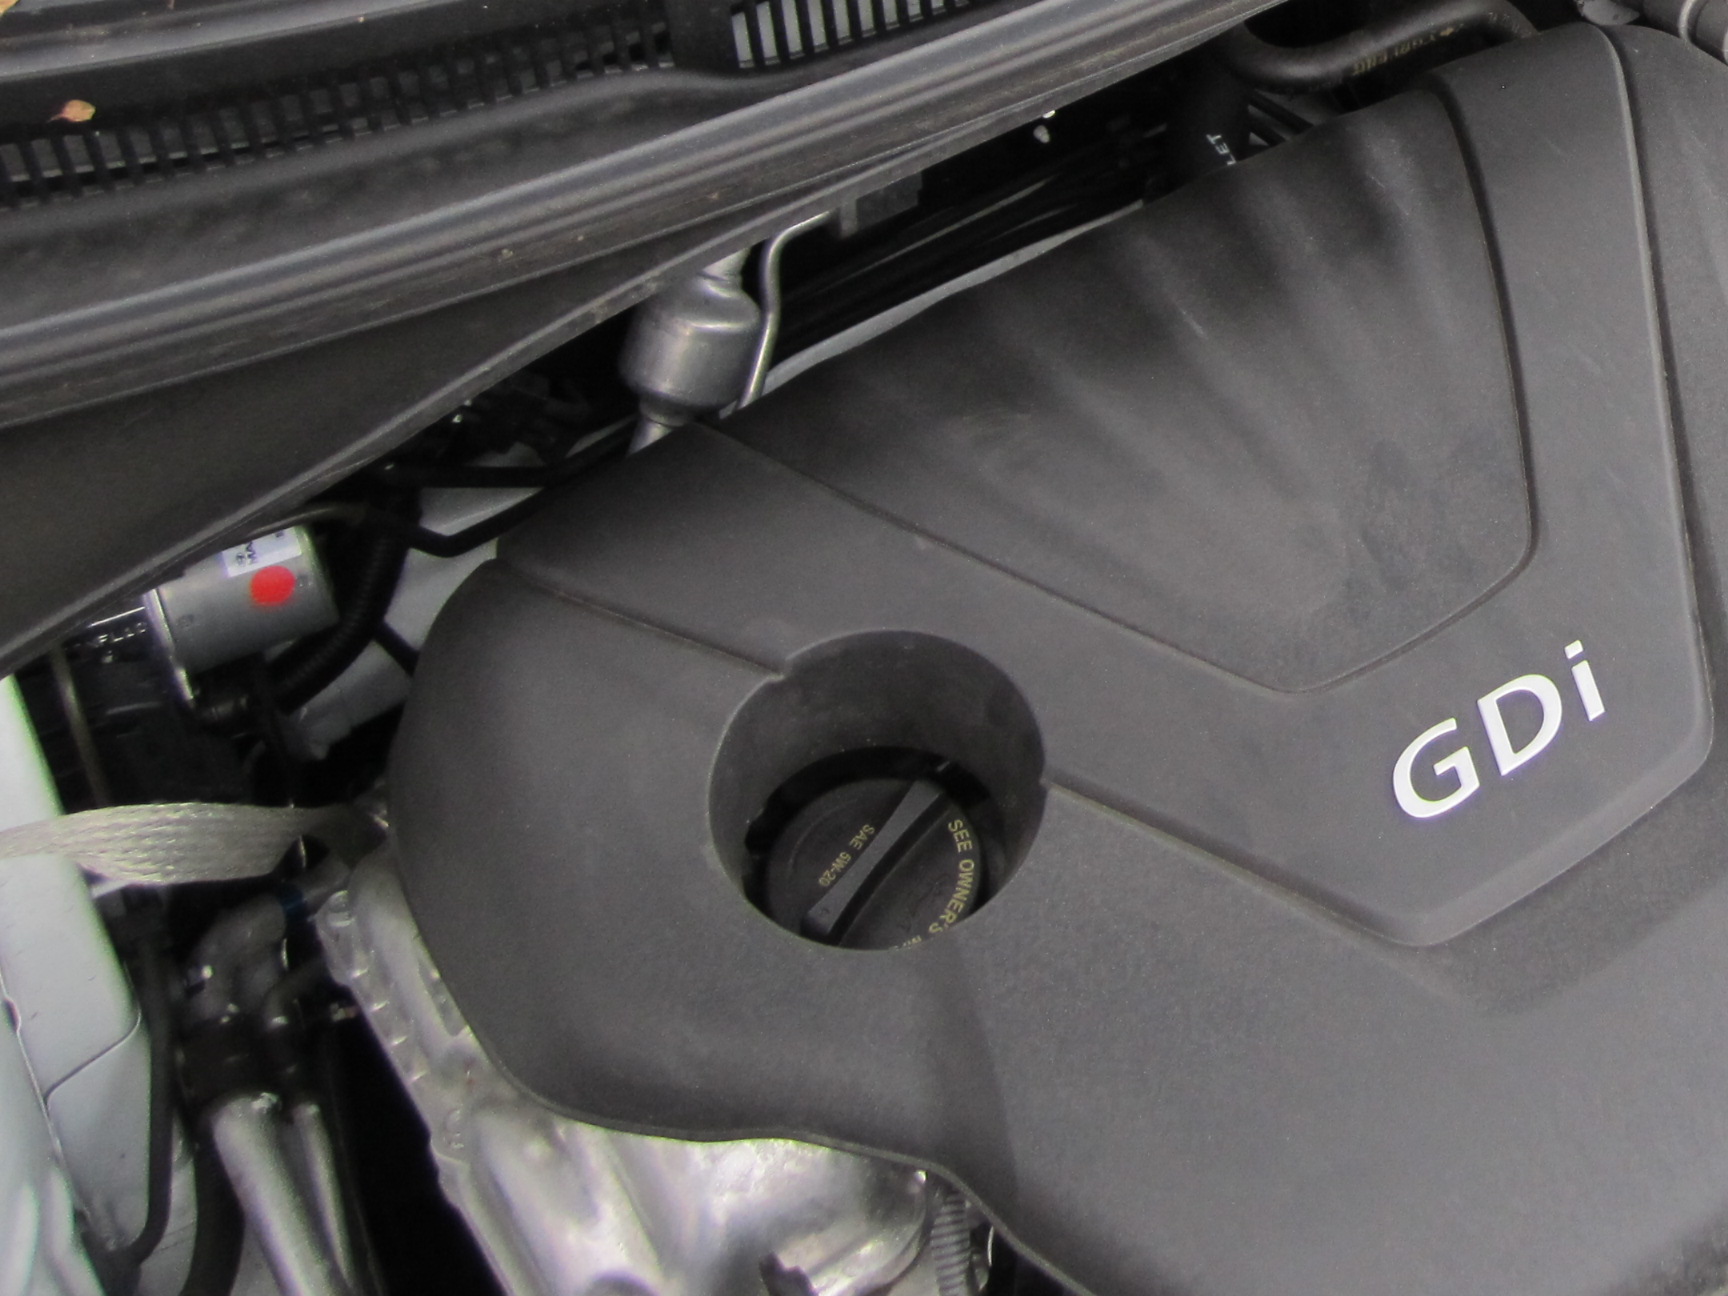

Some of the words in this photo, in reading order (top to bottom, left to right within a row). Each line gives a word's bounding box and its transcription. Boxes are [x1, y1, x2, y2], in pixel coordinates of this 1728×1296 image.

[1393, 639, 1606, 818] GDi
[849, 824, 875, 850] SAE
[947, 819, 972, 853] SEE
[818, 851, 852, 887] 5W-20
[928, 858, 975, 934] OWNER'S
